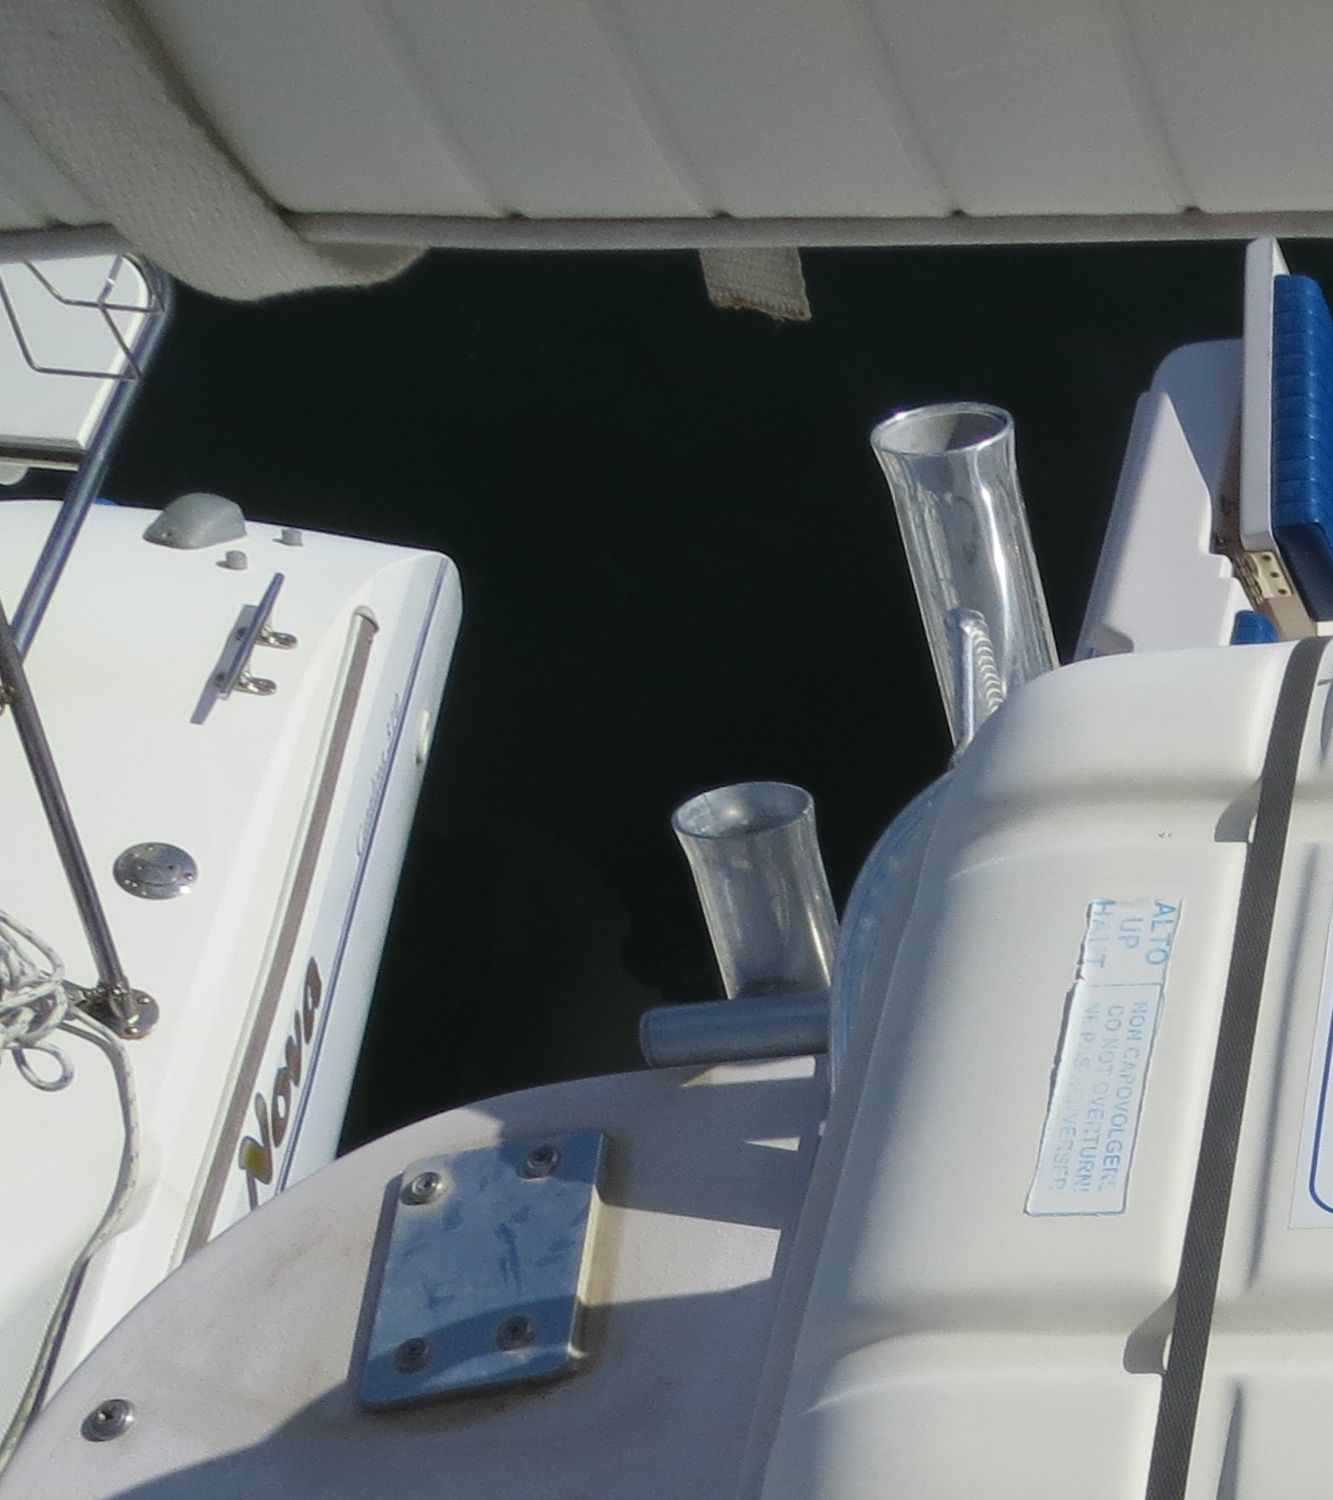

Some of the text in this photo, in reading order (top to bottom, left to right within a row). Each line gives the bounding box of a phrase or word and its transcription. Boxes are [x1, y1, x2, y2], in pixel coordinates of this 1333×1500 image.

[1118, 918, 1144, 950] UP
[1144, 899, 1178, 967] ALTO
[1104, 1005, 1124, 1032] DO
[1126, 1002, 1147, 1041] NON
[1097, 1038, 1118, 1076] NOT
